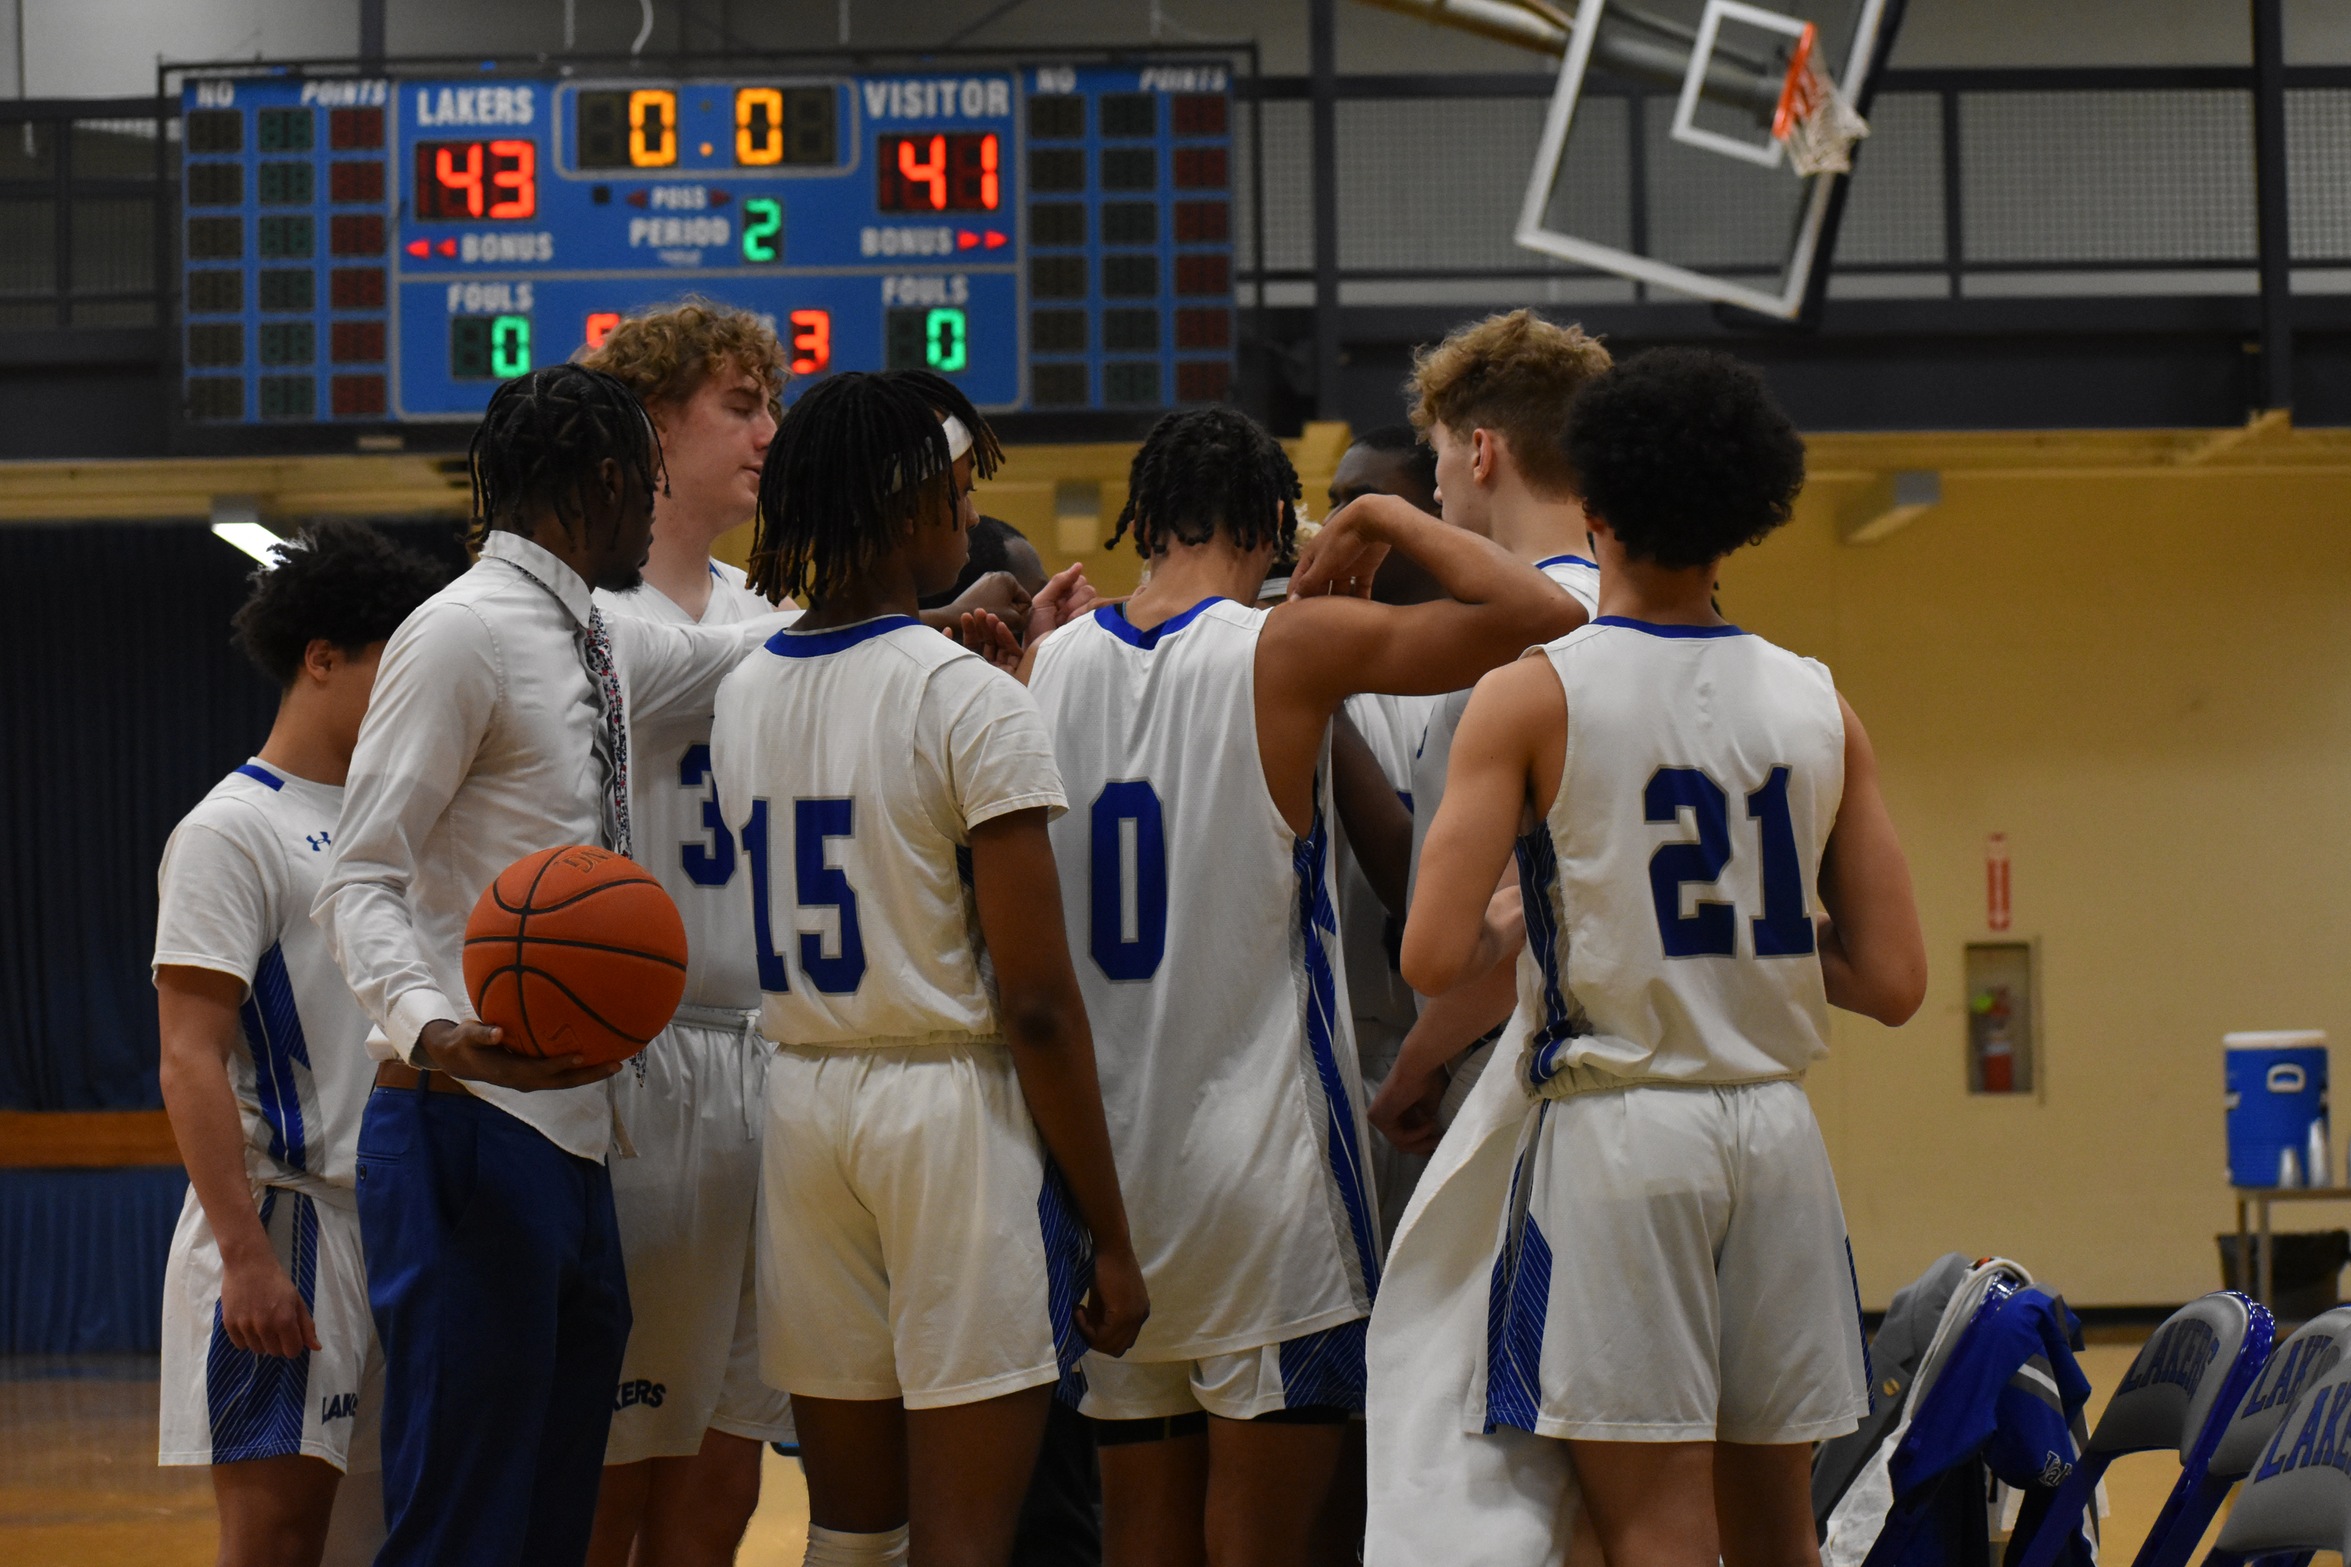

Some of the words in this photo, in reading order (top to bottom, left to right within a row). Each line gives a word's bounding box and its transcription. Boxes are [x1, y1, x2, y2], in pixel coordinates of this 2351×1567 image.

[302, 79, 388, 106] POINTS
[416, 86, 535, 127] LAKERS
[864, 78, 1011, 118] VISITOR
[435, 139, 536, 219] 43
[898, 133, 999, 211] 41
[461, 232, 554, 263] BONUS
[628, 216, 731, 248] PERIOD
[742, 198, 782, 262] 2
[859, 226, 955, 257] BONUS
[447, 282, 534, 314] FOULS
[881, 275, 969, 304] FOULS
[491, 314, 531, 379] 0
[789, 309, 830, 374] 3
[926, 307, 967, 372] 0
[1087, 776, 1168, 985] 0
[1641, 763, 1816, 960] 21
[740, 795, 868, 996] 15
